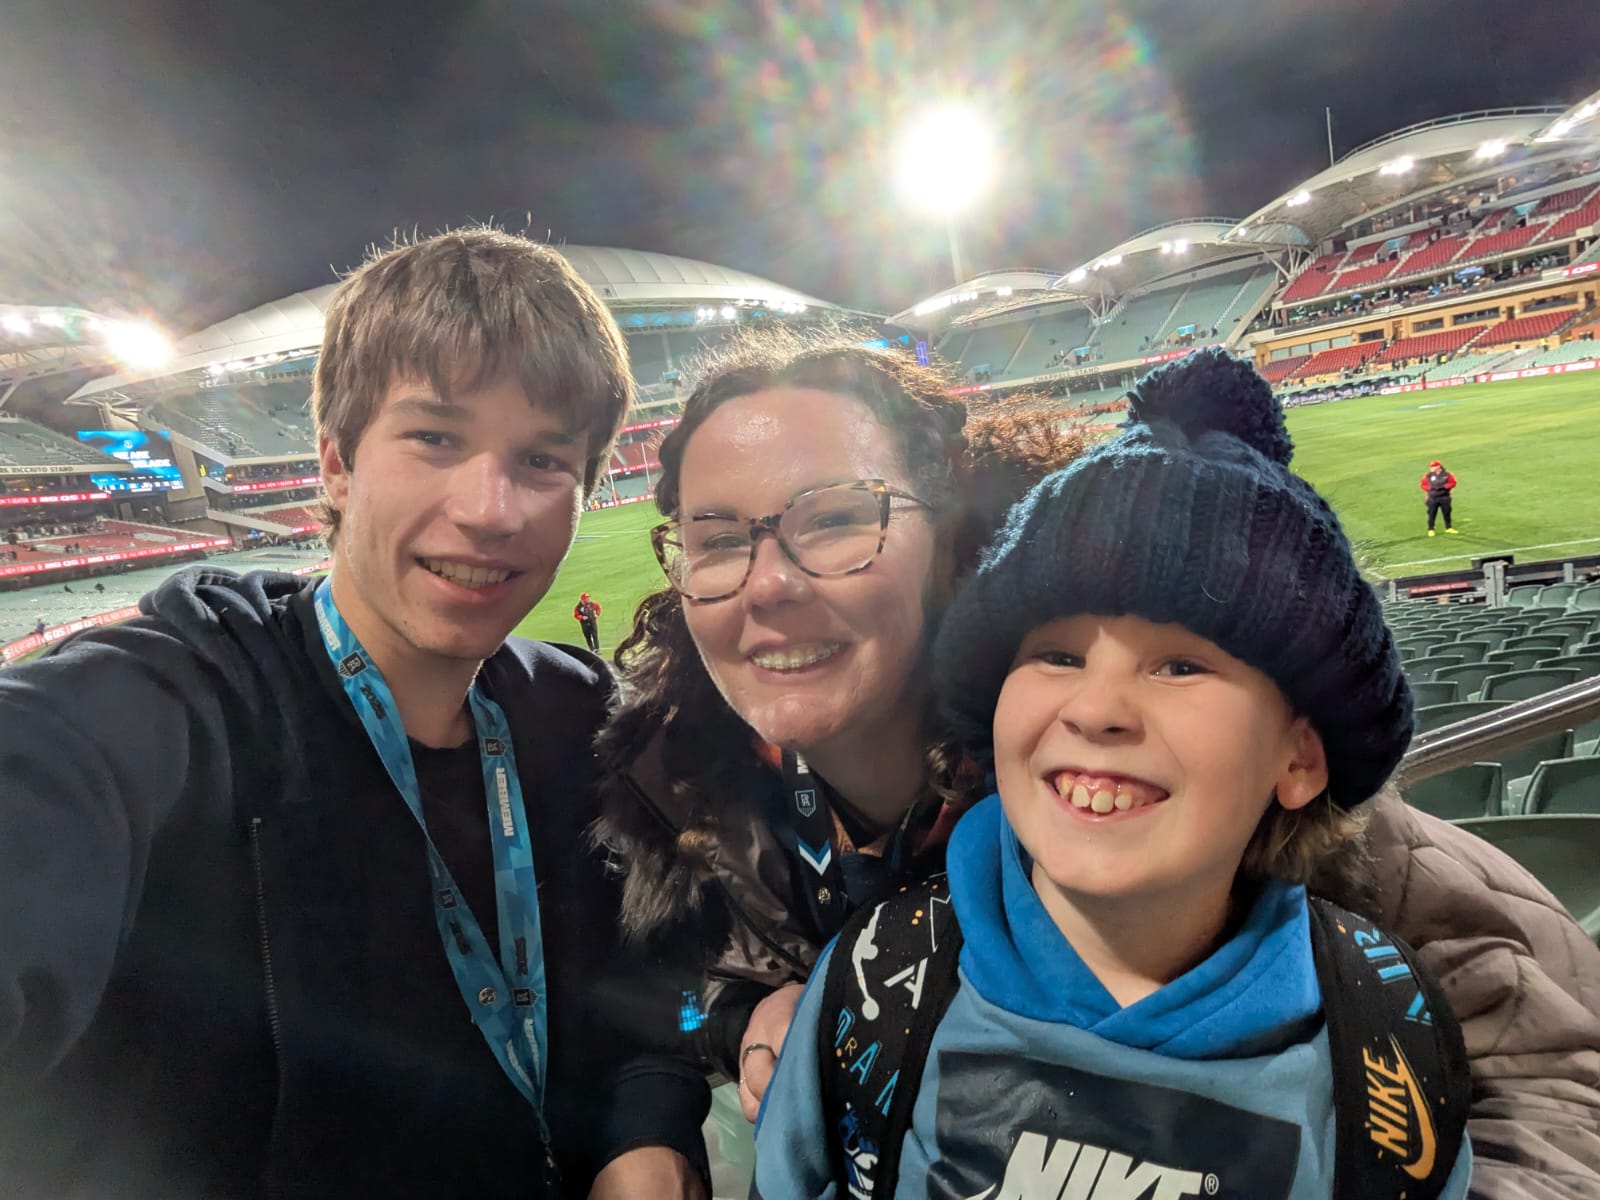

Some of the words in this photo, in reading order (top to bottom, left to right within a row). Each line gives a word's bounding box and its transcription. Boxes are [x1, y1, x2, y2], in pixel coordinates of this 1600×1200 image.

[50, 464, 74, 473] STAND
[496, 767, 514, 837] MEMBER
[1362, 1046, 1410, 1158] NIKE
